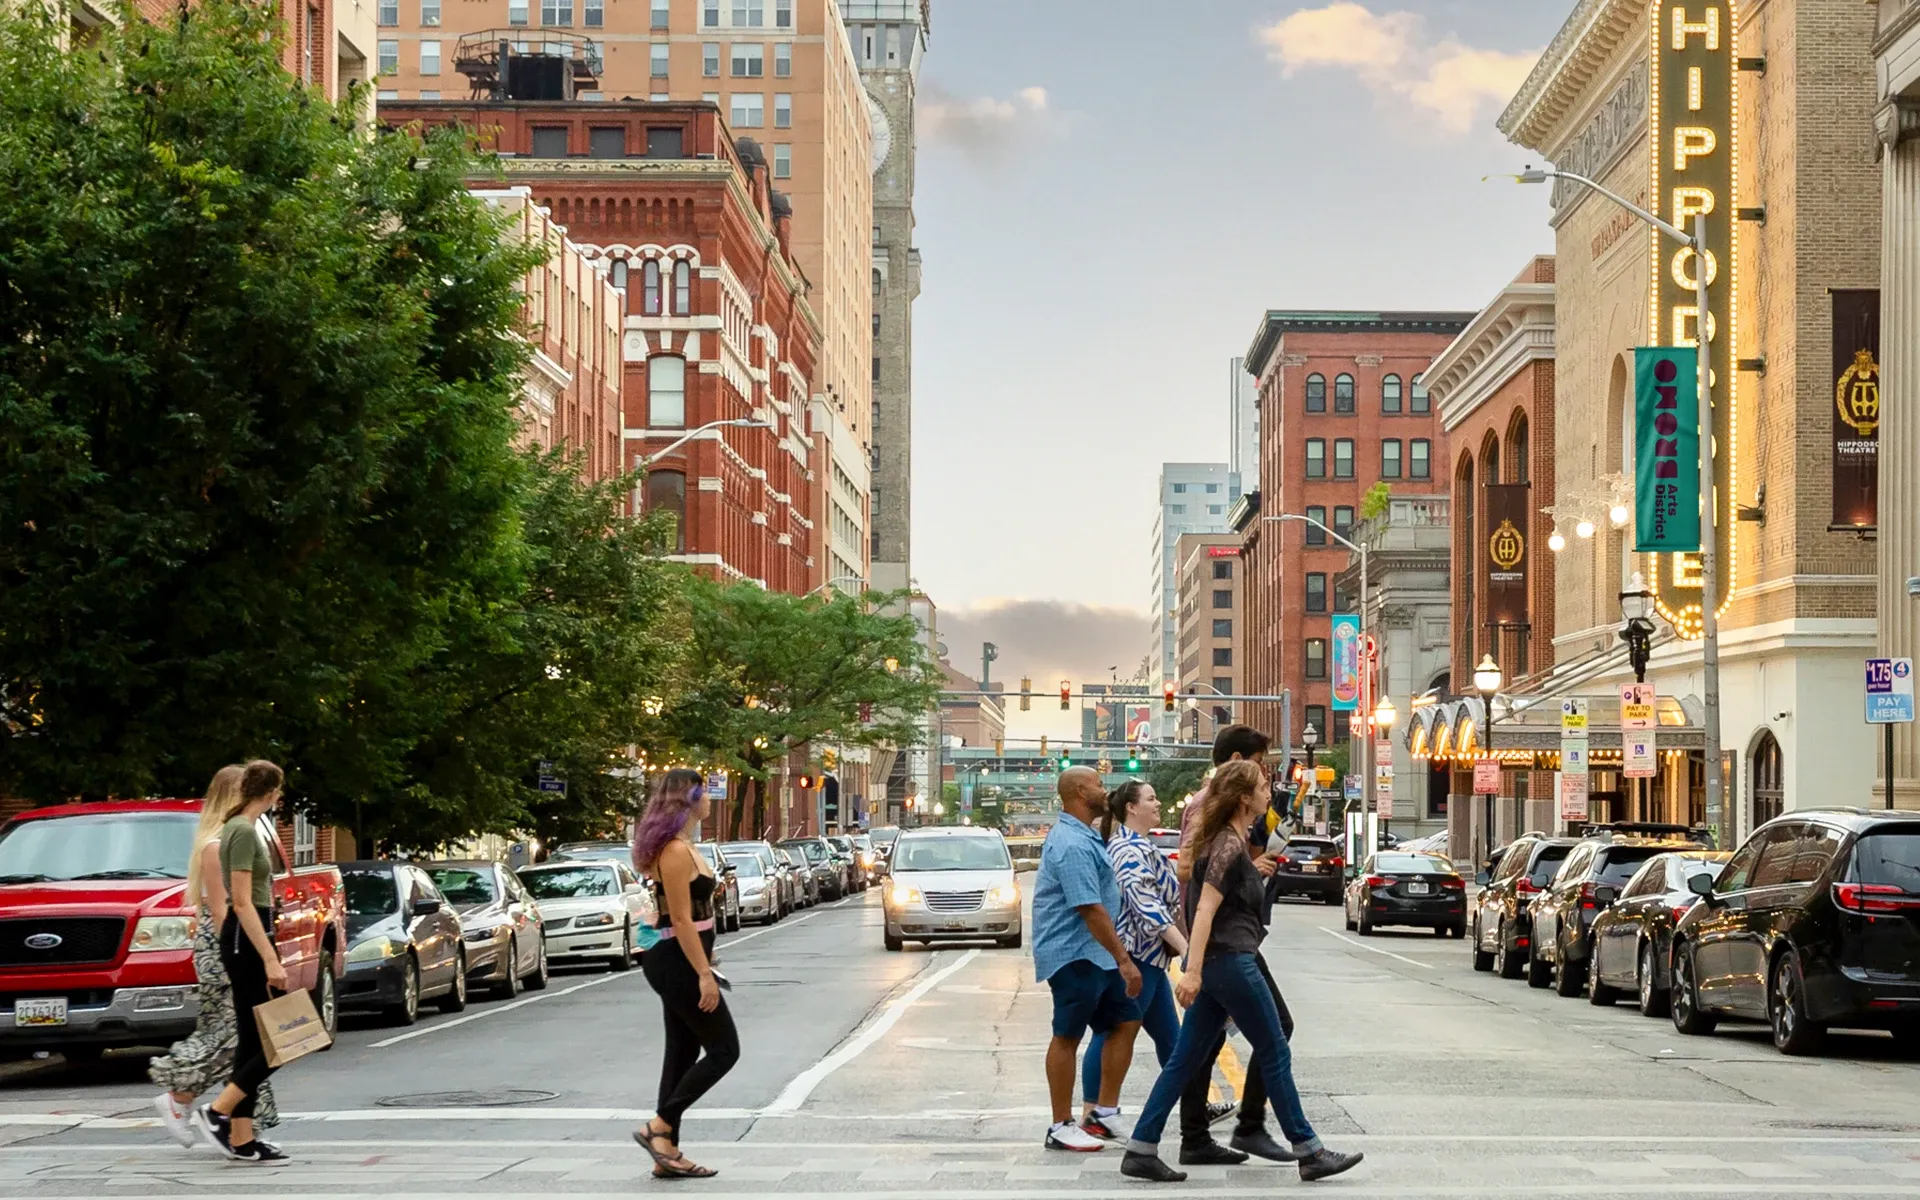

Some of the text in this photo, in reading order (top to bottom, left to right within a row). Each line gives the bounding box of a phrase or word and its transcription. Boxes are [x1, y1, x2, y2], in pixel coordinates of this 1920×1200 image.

[1668, 484, 1679, 516] Arts
[1655, 484, 1666, 540] District
[1866, 662, 1891, 682] $1.75
[1896, 662, 1906, 673] 4
[1878, 697, 1901, 707] PAY
[1873, 708, 1907, 717] HERE
